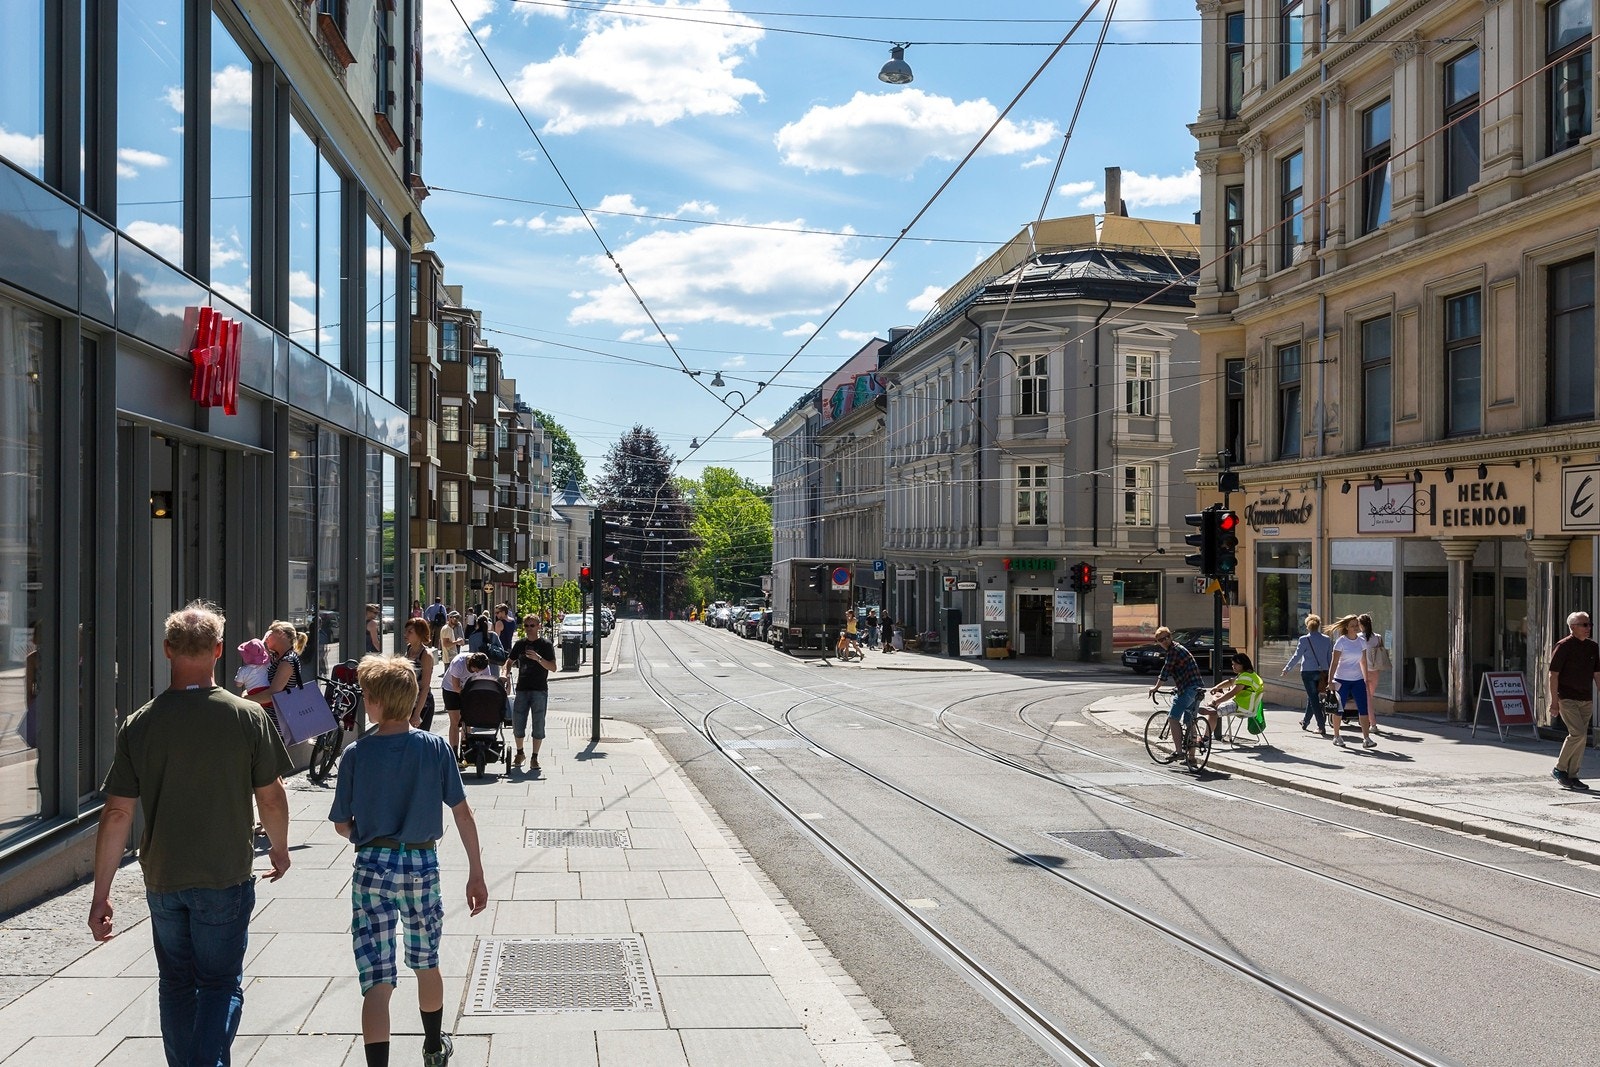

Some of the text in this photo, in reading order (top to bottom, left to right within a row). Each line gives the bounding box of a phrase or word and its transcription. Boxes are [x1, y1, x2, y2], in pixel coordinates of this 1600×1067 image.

[1458, 482, 1508, 502] HEKA
[1442, 506, 1526, 527] EIENDOM
[538, 562, 546, 572] P
